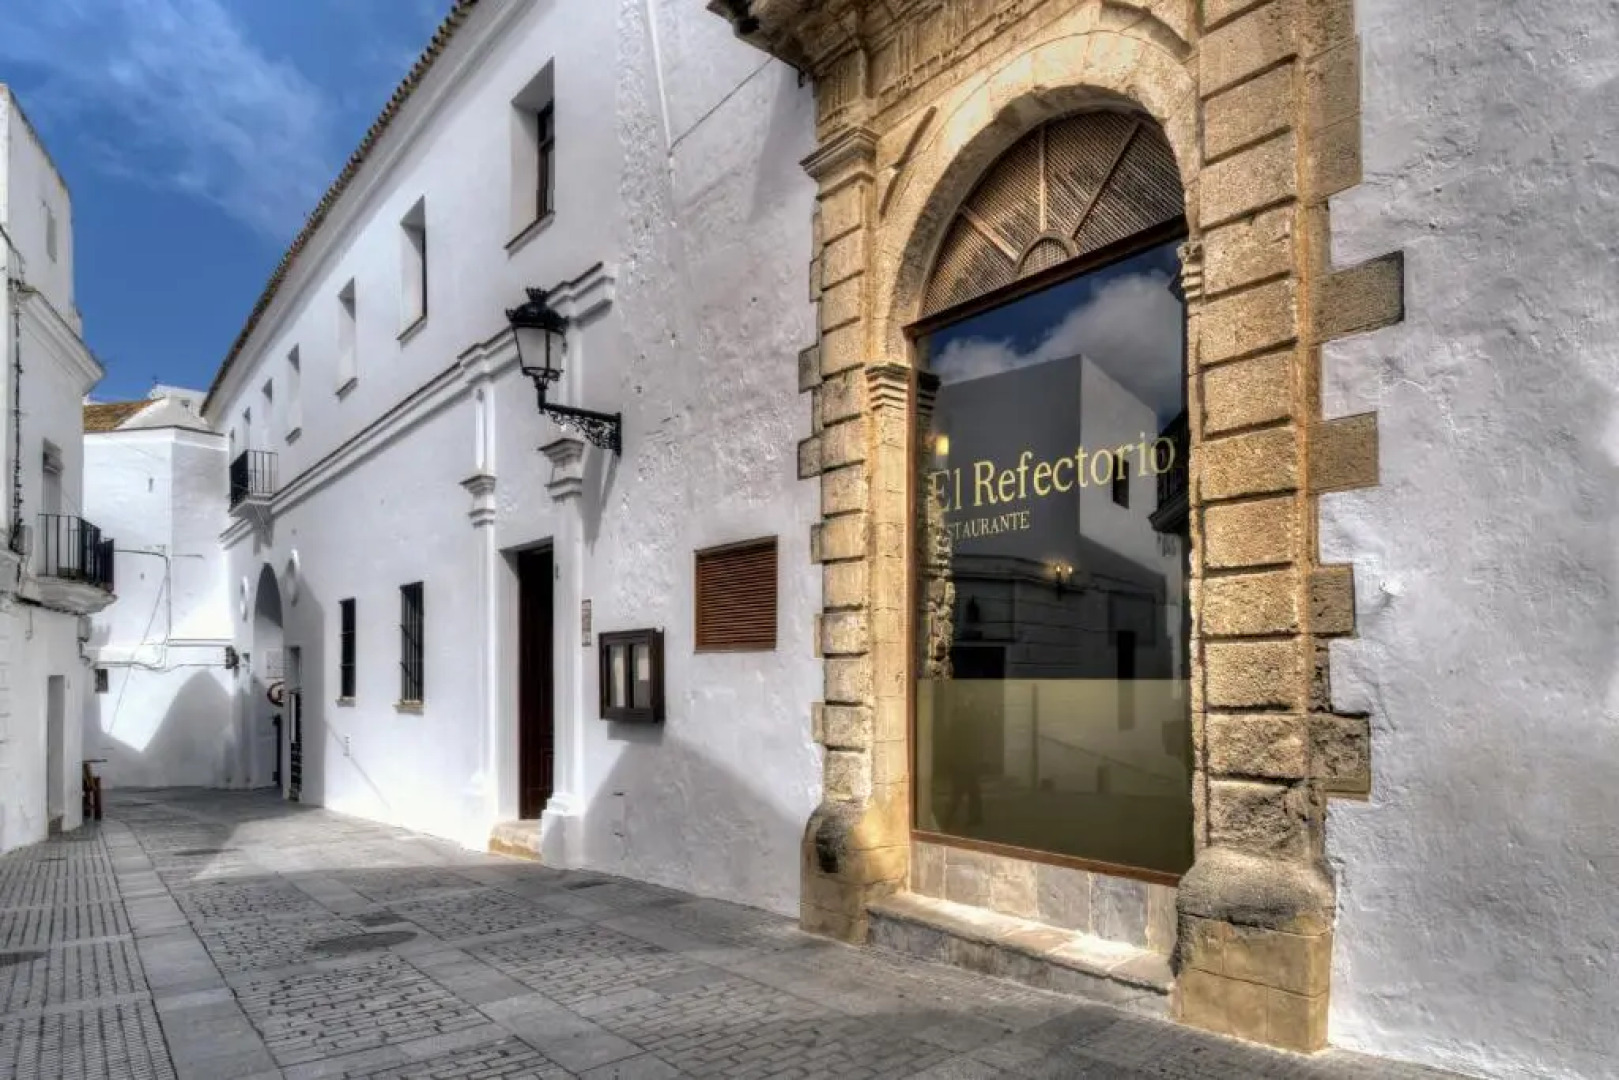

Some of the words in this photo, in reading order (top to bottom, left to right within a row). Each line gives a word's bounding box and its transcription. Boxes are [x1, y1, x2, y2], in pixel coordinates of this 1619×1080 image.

[928, 468, 962, 512] El
[973, 431, 1176, 507] Refectorio
[942, 510, 1031, 542] STAURANTE
